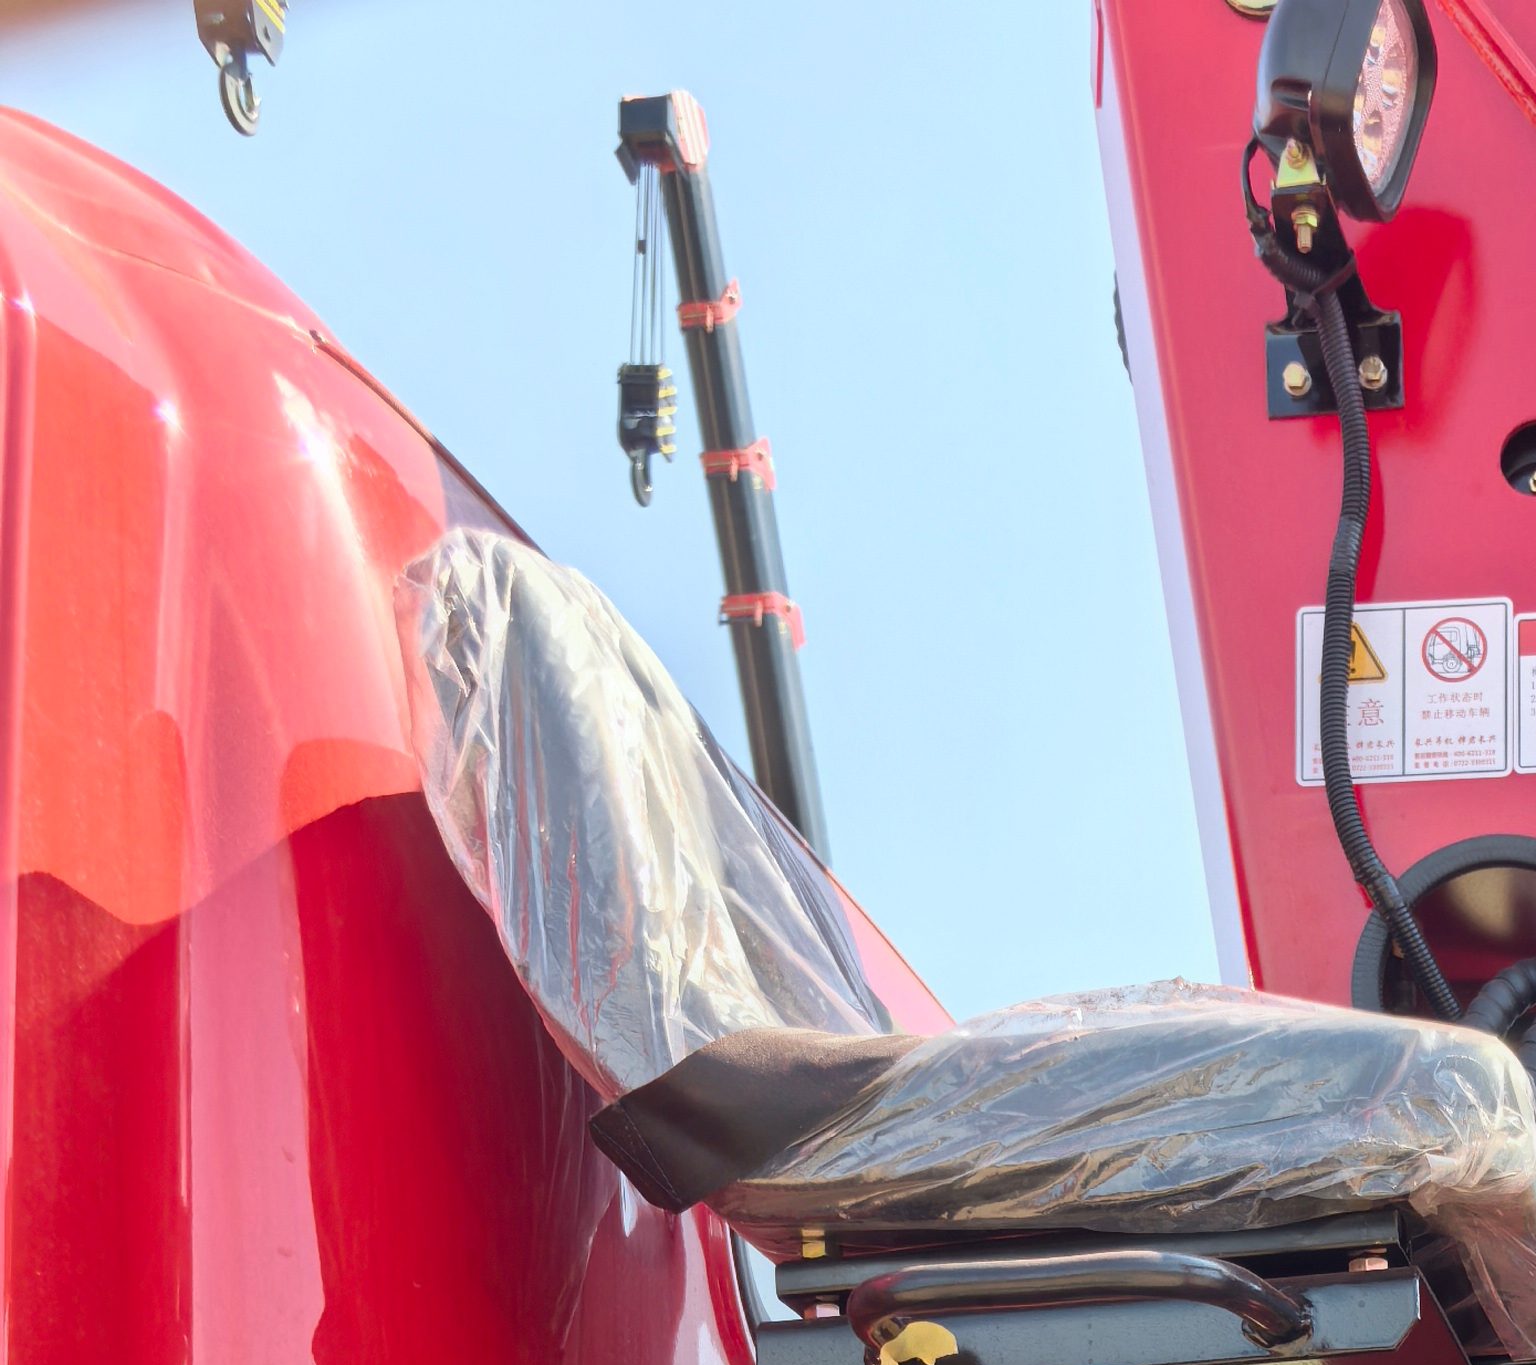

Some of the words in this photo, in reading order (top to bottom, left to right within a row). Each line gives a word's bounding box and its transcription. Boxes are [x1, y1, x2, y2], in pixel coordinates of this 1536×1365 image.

[1427, 692, 1483, 703] 工作状态时
[1346, 699, 1384, 726] 意
[1421, 707, 1490, 720] 禁止移动车辆
